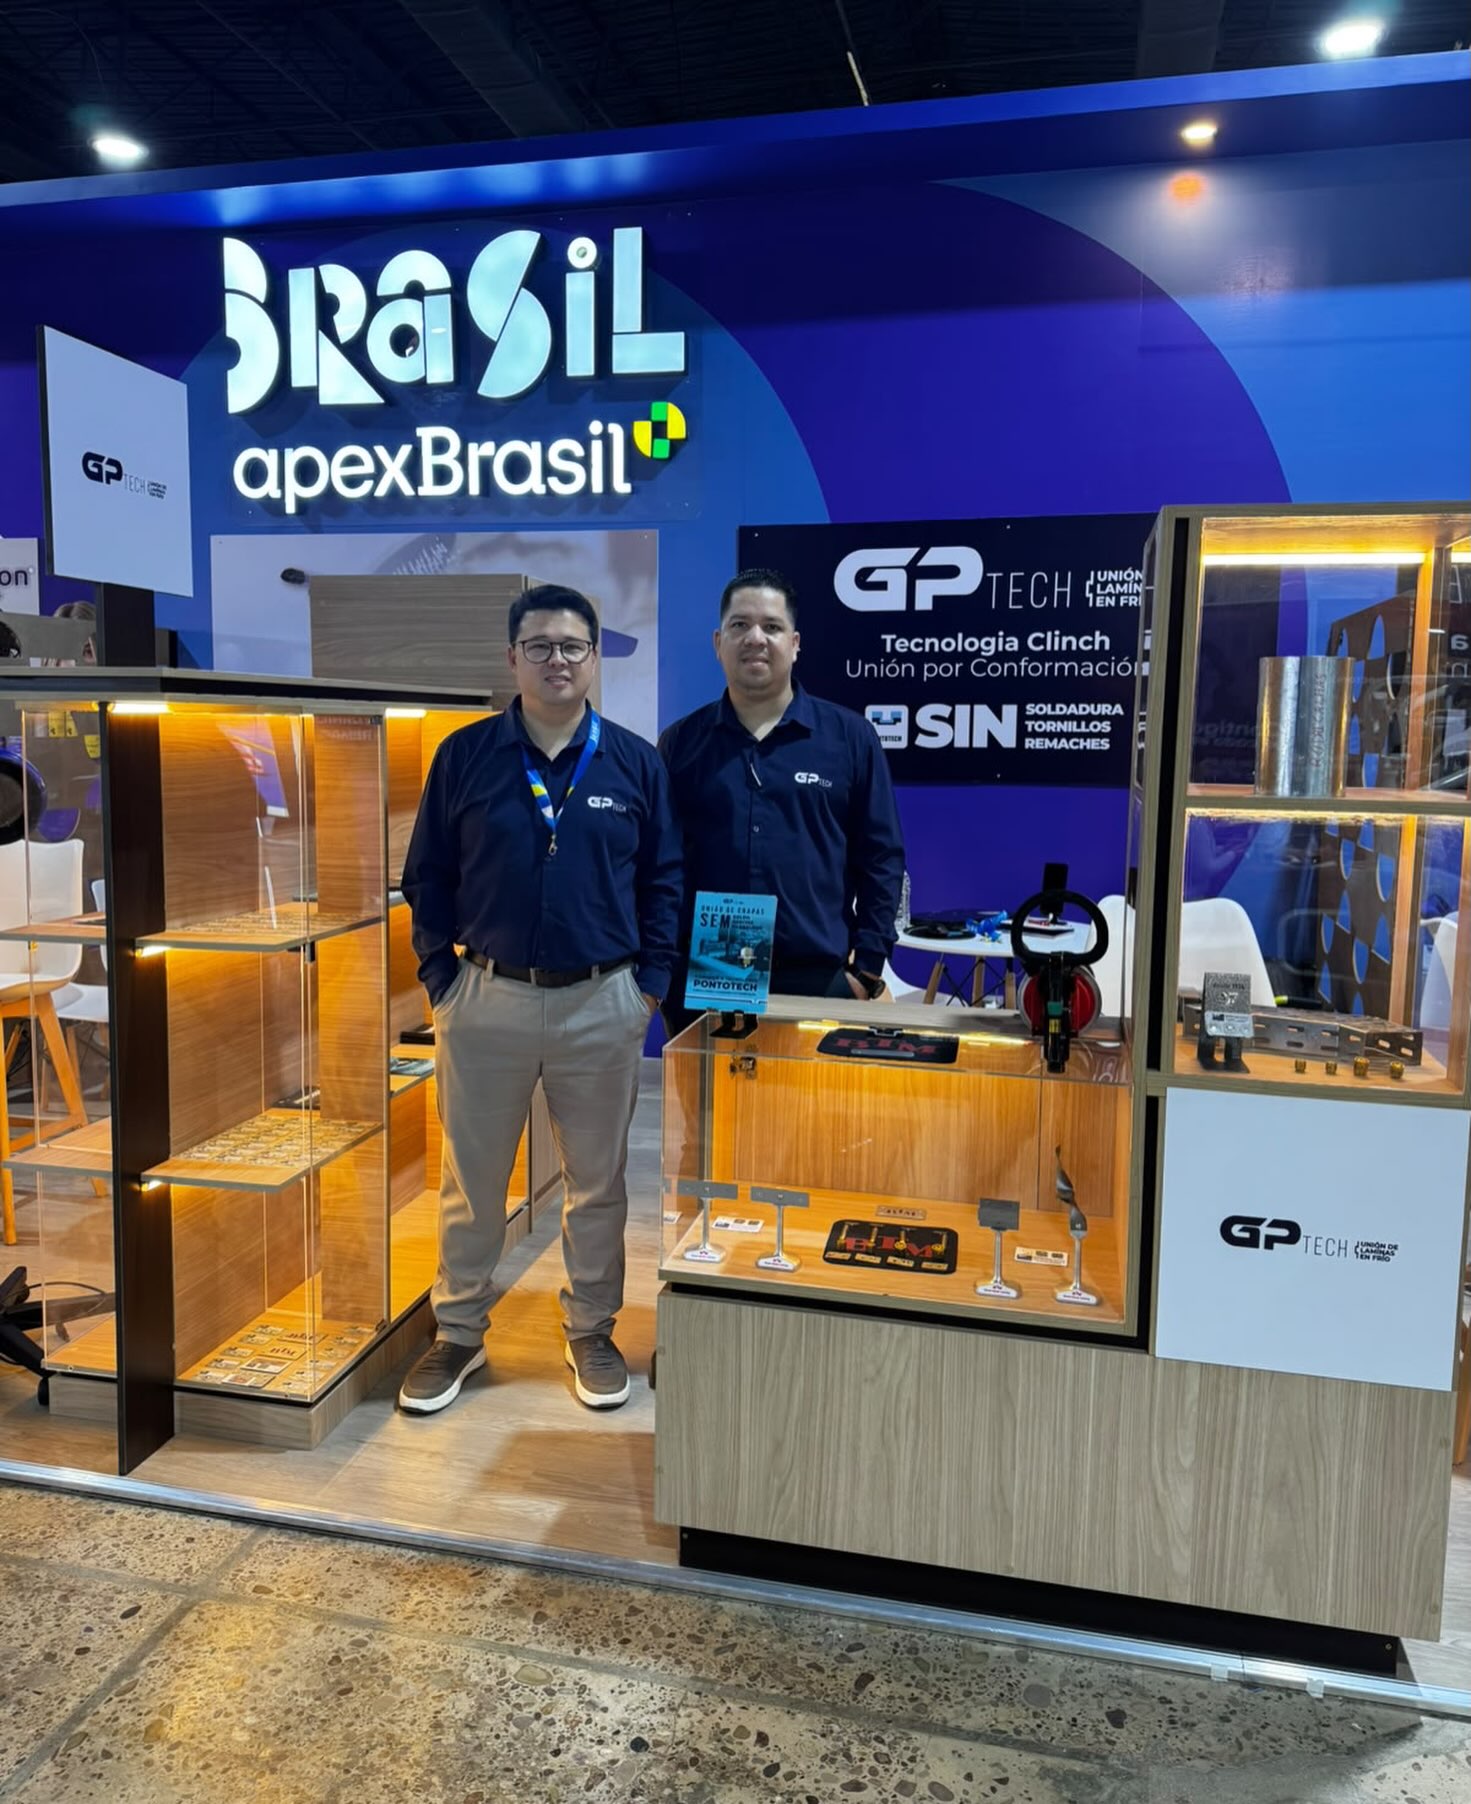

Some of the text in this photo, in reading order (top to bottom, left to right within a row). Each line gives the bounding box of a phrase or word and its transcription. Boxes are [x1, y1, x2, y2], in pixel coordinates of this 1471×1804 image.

[233, 421, 631, 514] apexBrasil
[987, 571, 1072, 610] TECH
[1095, 595, 1116, 608] EN
[881, 631, 1111, 656] Tecnologia Clinch
[846, 658, 915, 678] Unión
[922, 661, 963, 682] por
[915, 703, 1124, 749] SIN SOLDADURA
[1025, 720, 1112, 733] TORNILLOS
[1025, 737, 1110, 750] REMACHES
[700, 913, 731, 929] SEM
[693, 978, 758, 992] PONTOTECH
[1303, 1234, 1349, 1258] TECH
